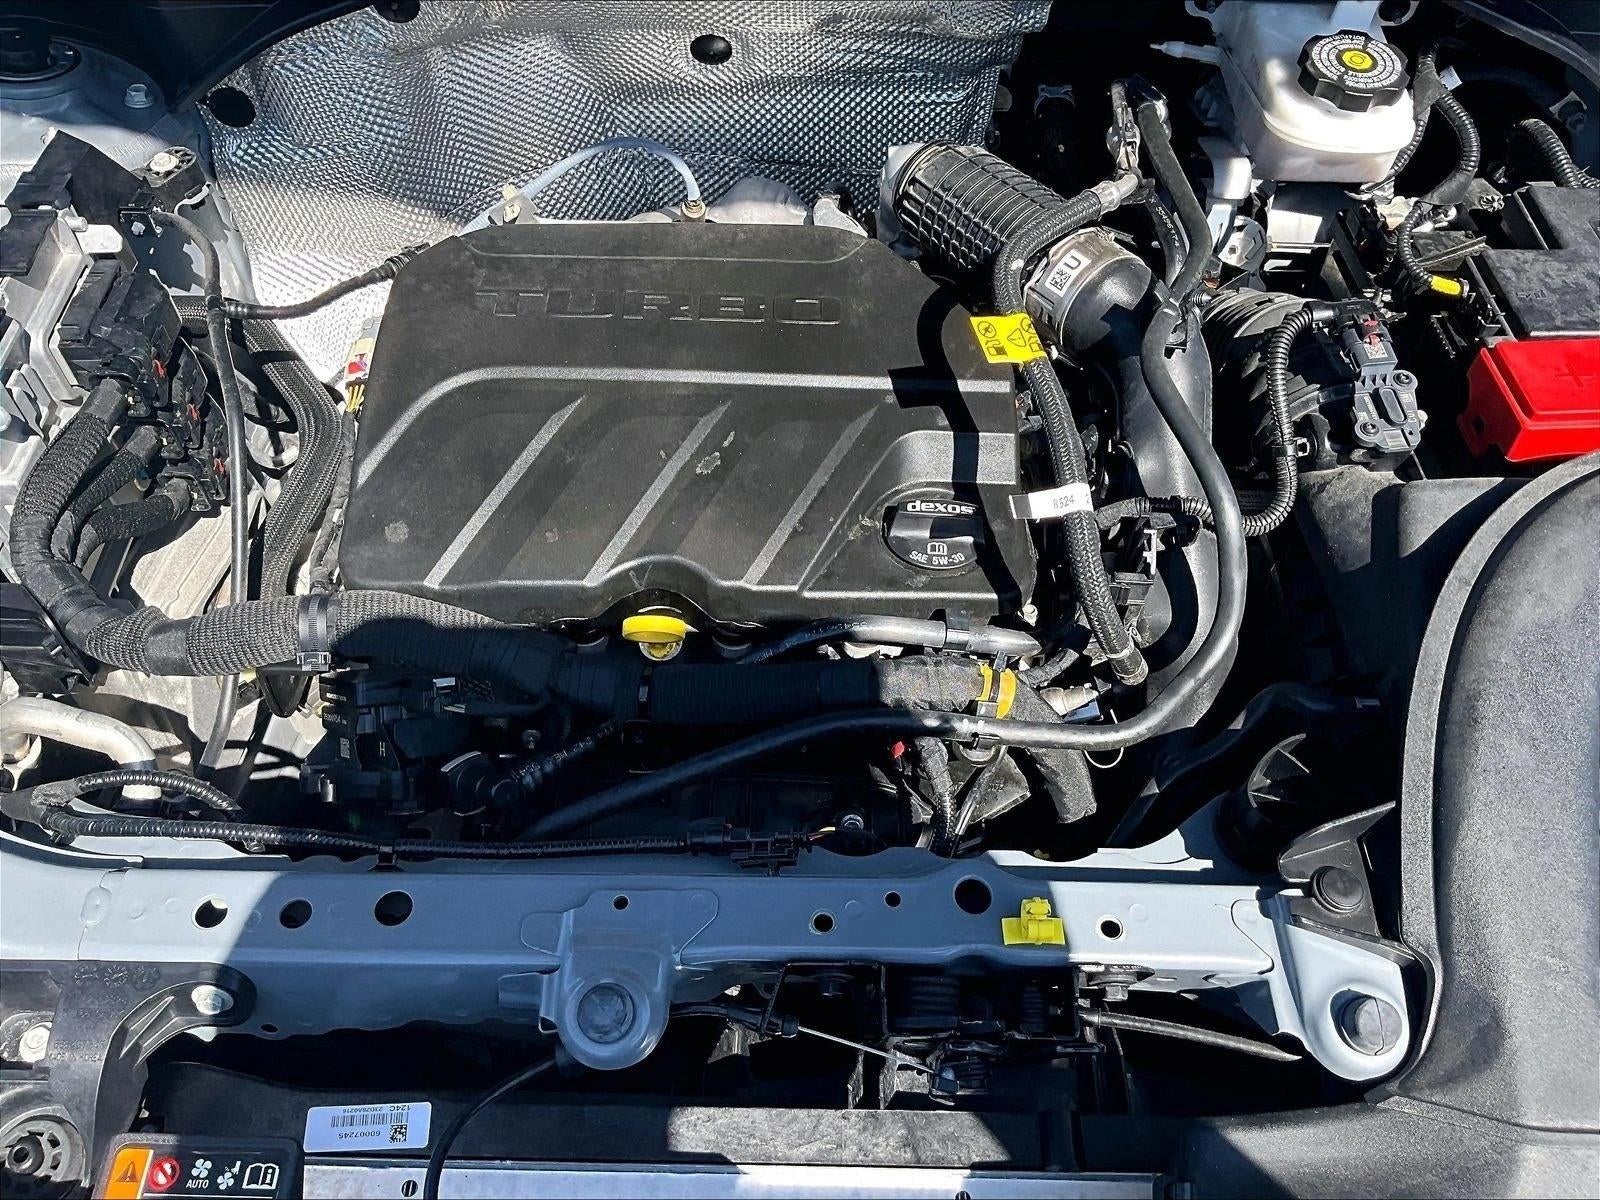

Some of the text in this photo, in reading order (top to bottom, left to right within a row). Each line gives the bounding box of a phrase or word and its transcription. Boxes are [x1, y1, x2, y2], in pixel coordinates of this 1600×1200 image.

[1063, 255, 1082, 270] U
[474, 288, 841, 325] TURBO
[906, 499, 974, 515] dexos
[909, 550, 965, 565] SAE 5W-30
[389, 1104, 410, 1112] 124C
[338, 1130, 381, 1139] 60007245
[185, 1179, 209, 1189] AUTO
